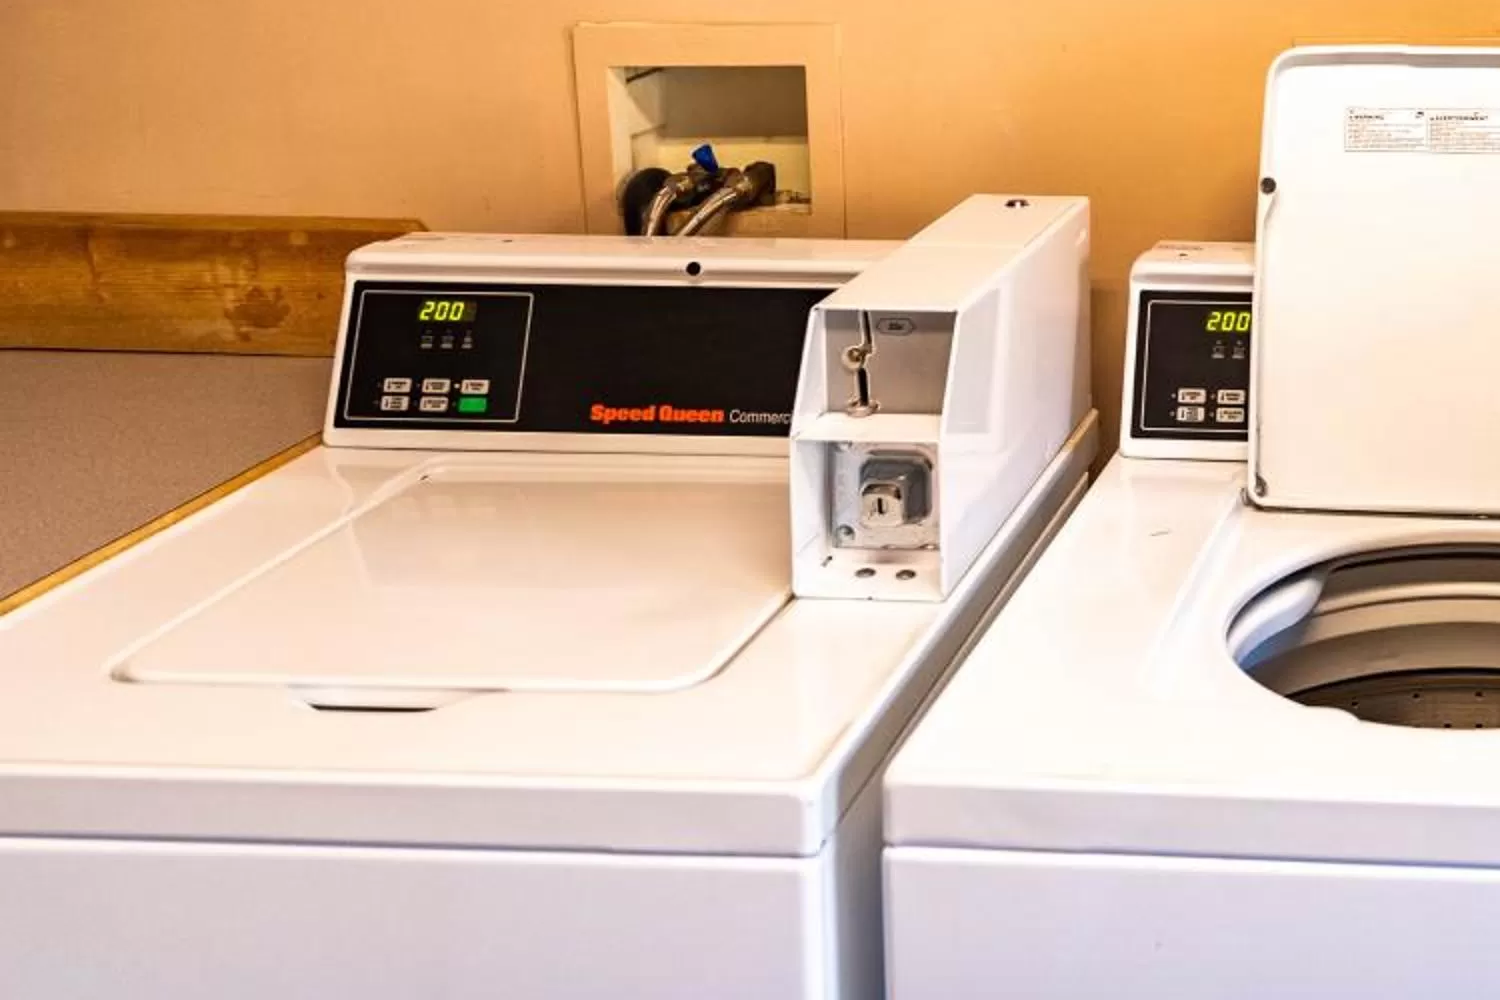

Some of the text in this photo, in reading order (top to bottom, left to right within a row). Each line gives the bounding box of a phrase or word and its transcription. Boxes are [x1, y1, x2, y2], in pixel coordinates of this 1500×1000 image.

[418, 301, 465, 321] 200
[1206, 311, 1251, 332] 200
[590, 404, 656, 424] Speed
[659, 404, 725, 424] Queen
